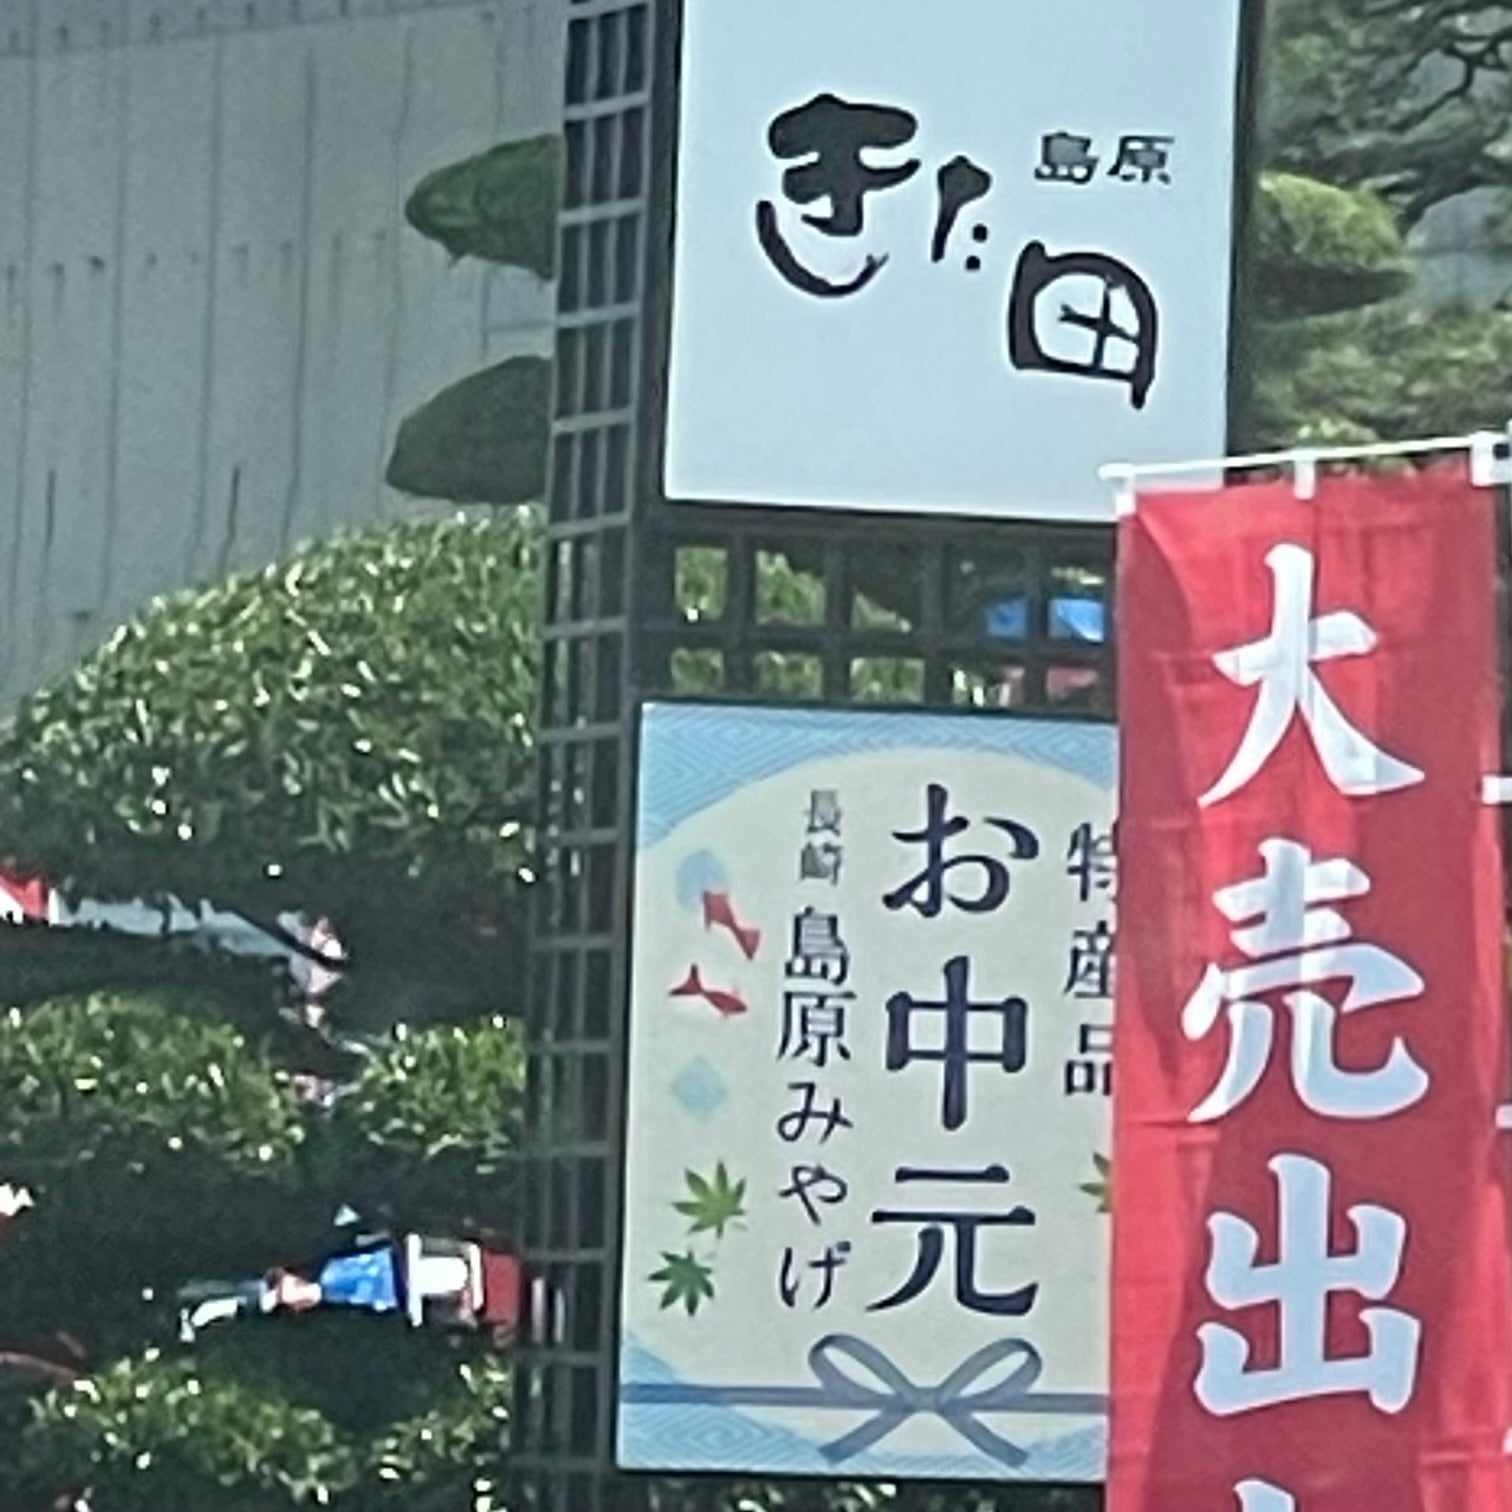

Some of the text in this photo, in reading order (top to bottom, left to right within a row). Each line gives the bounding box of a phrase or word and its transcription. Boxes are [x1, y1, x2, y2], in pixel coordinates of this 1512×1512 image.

[1032, 130, 1175, 186] 島原
[776, 905, 857, 1312] 島原みやげ
[866, 782, 1040, 1317] お中元
[1180, 542, 1429, 1512] 大売出
